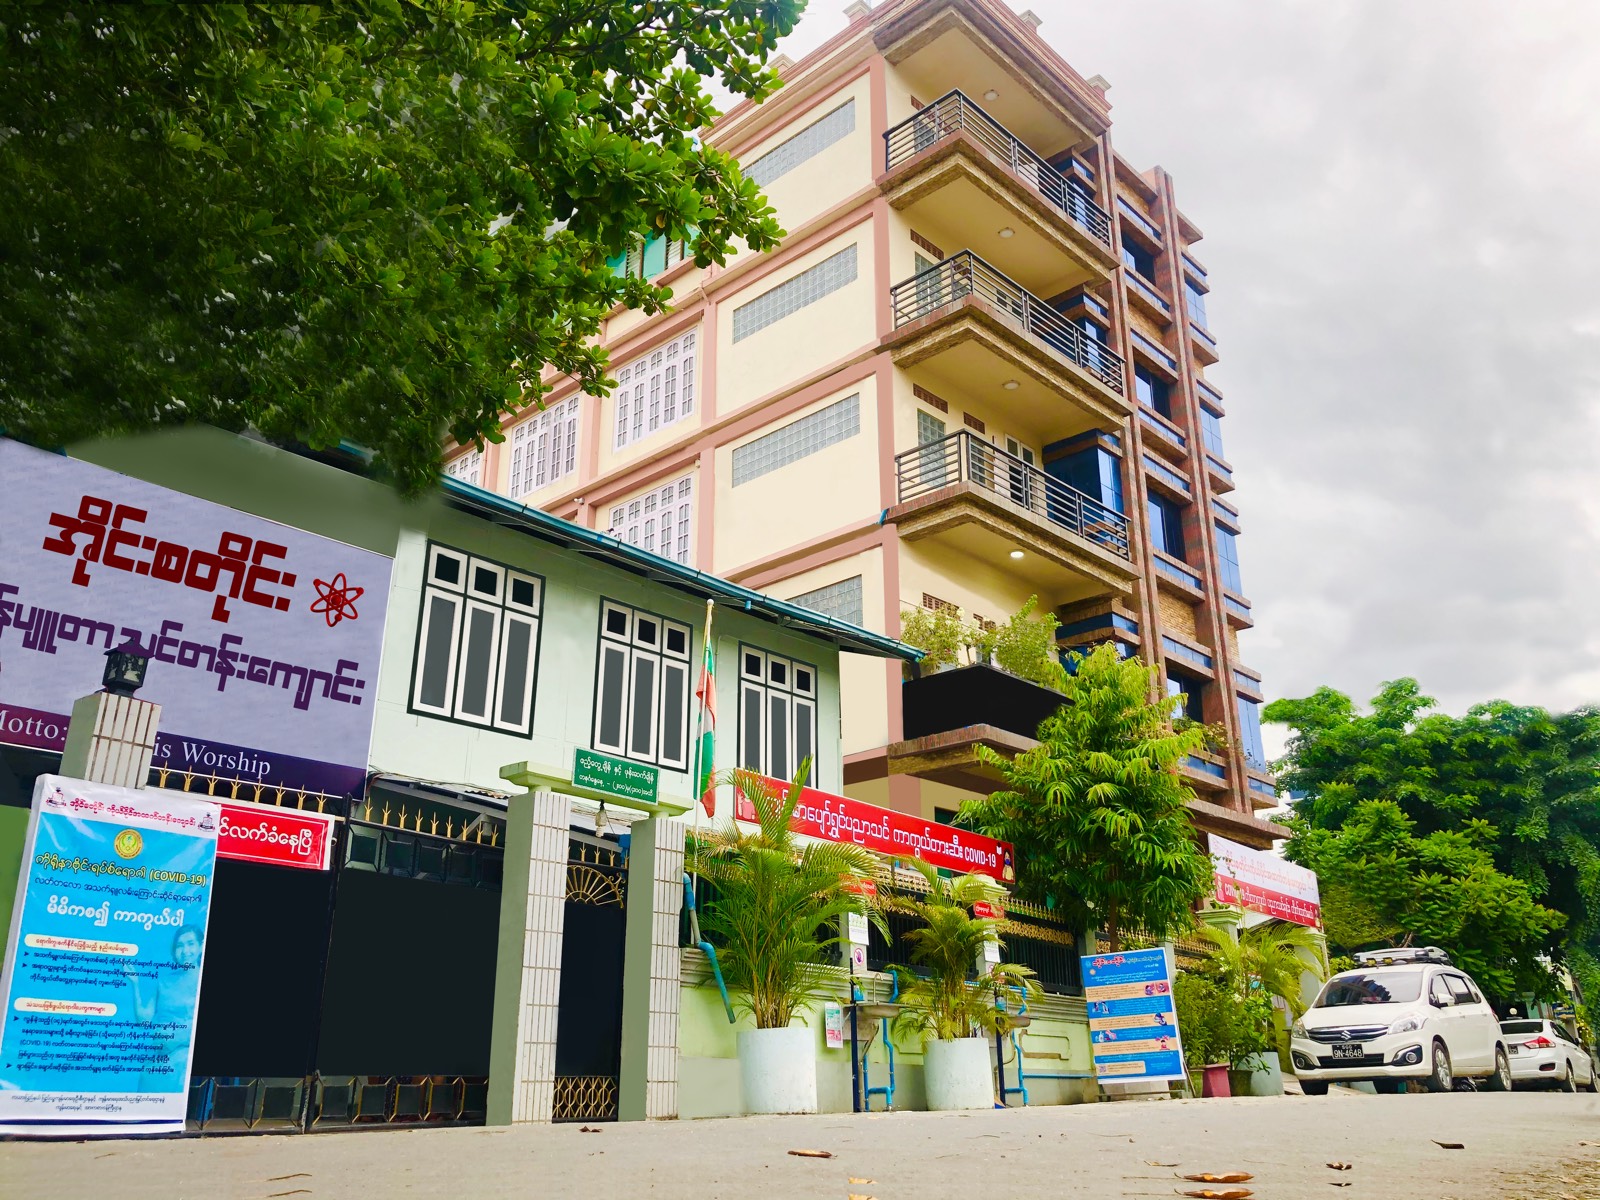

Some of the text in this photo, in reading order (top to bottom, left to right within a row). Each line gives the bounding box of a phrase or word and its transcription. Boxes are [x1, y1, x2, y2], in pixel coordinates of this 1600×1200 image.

[42, 495, 297, 623] အိုင်းစတိုင်း
[153, 736, 171, 758] is
[182, 741, 271, 779] Worship
[893, 827, 963, 862] ကာကွယ်တားဆီး
[964, 848, 996, 868] COVID-19
[34, 876, 82, 890] လတ်တလော
[149, 869, 207, 887] (COVID-19)
[46, 894, 185, 931] မိမိကစ၍ ကာကွယ်ပါ
[1333, 1048, 1362, 1058] 9N-4648
